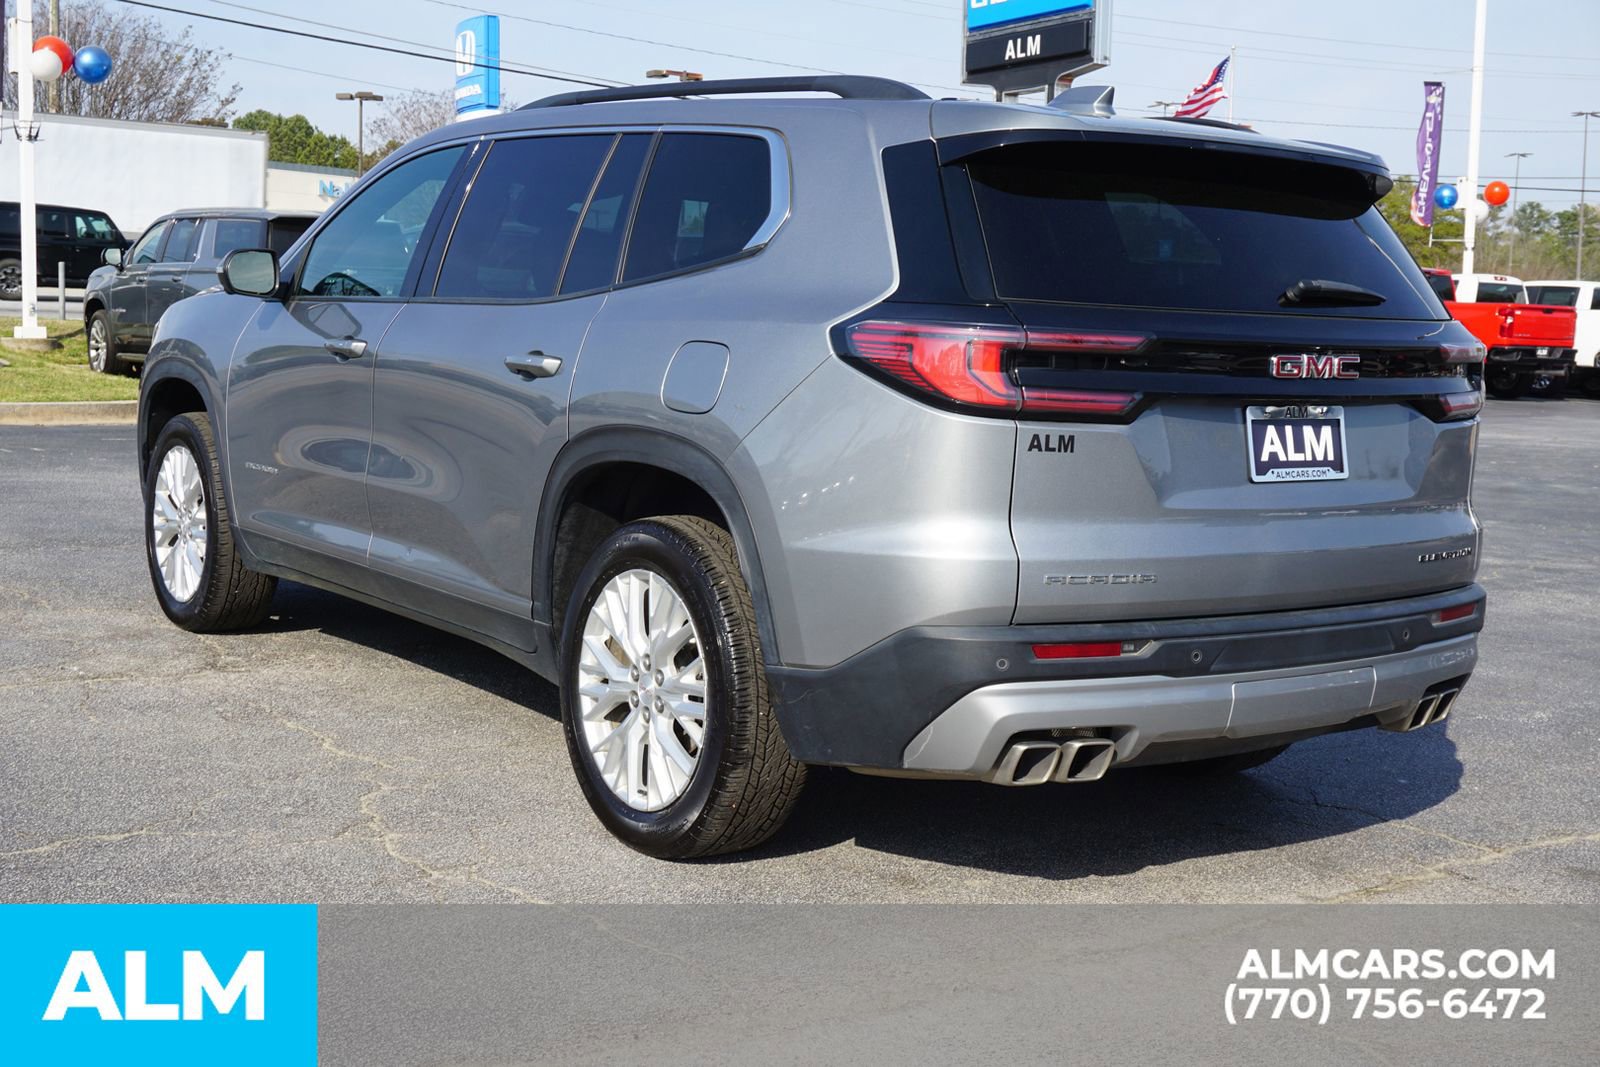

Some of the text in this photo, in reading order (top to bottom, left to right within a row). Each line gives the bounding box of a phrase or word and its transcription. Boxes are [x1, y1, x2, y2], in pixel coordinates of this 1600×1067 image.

[1004, 34, 1041, 61] ALM
[1271, 354, 1360, 379] GMC
[1285, 406, 1308, 418] ALM
[1027, 433, 1075, 453] ALM
[1260, 425, 1335, 462] ALM
[1275, 468, 1328, 479] ALMCARS.COM
[1043, 574, 1158, 585] ACADIA
